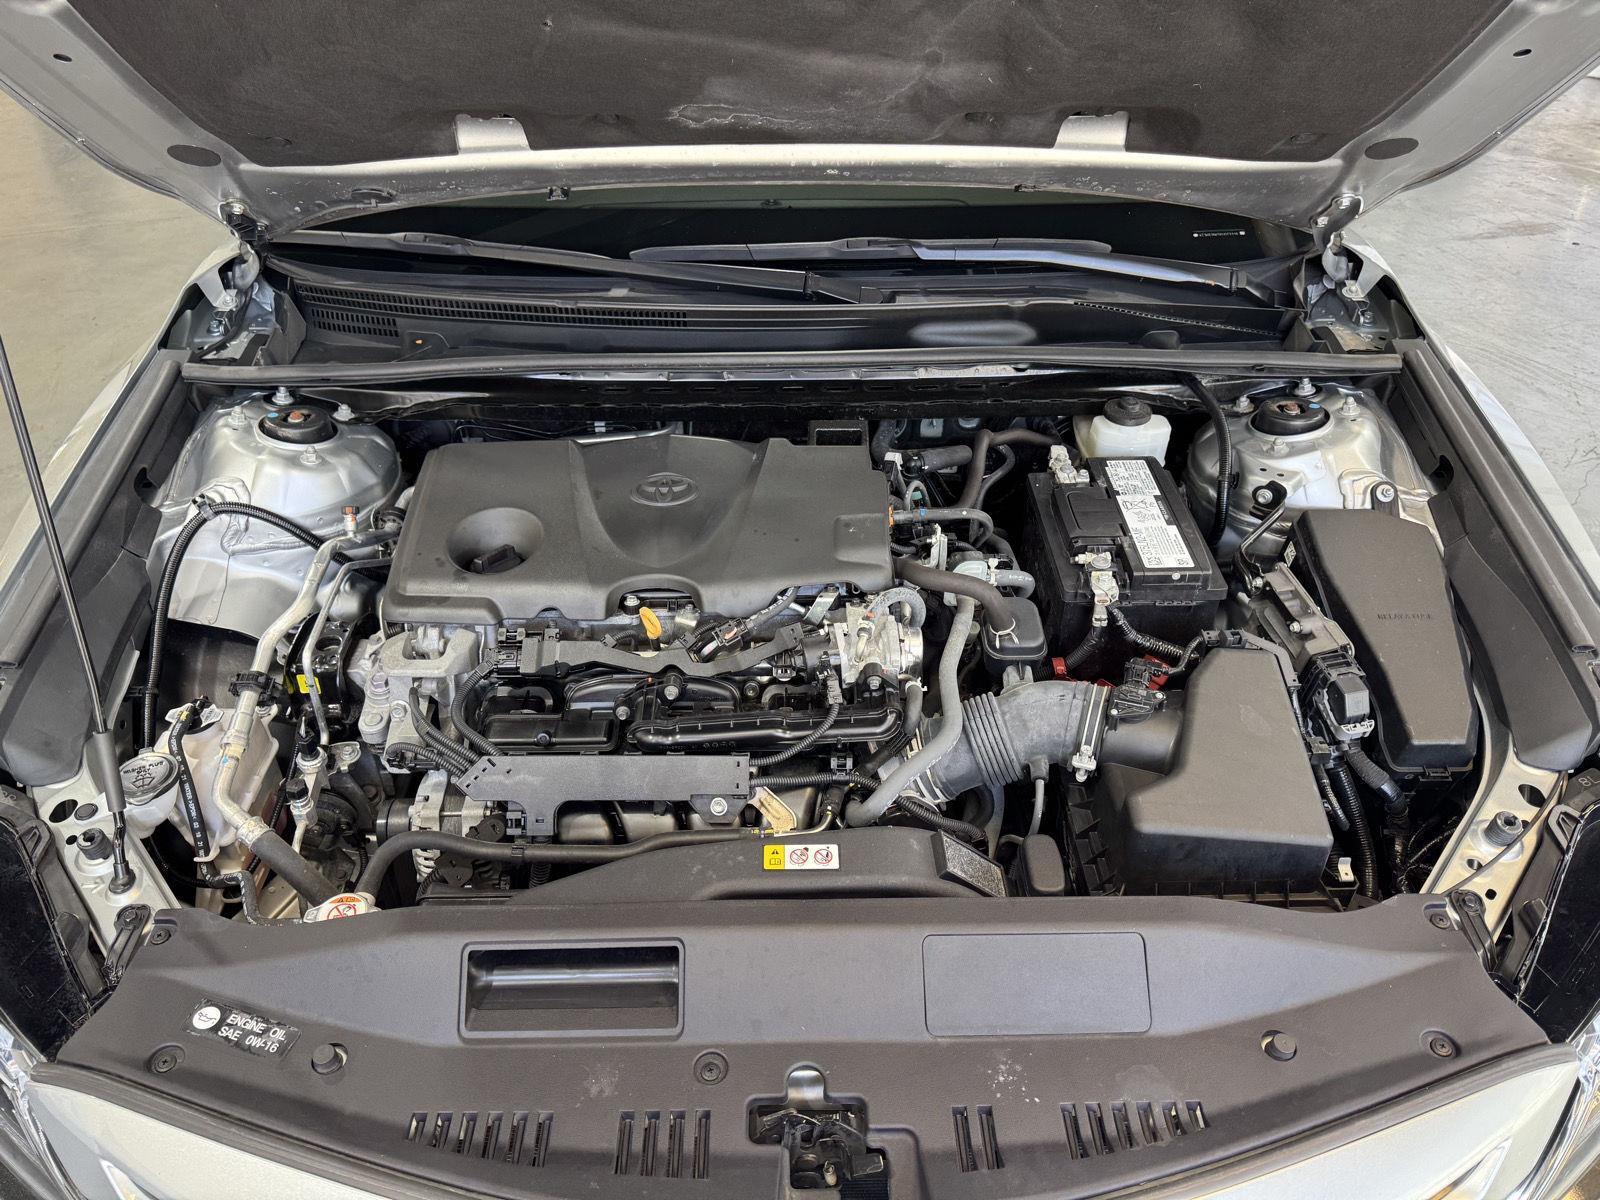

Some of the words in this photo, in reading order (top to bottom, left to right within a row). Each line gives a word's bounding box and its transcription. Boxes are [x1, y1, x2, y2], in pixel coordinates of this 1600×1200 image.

[217, 1026, 242, 1041] SAE
[245, 1034, 280, 1053] 0W-16
[226, 1013, 268, 1034] ENGINE
[269, 1027, 287, 1041] OIL
